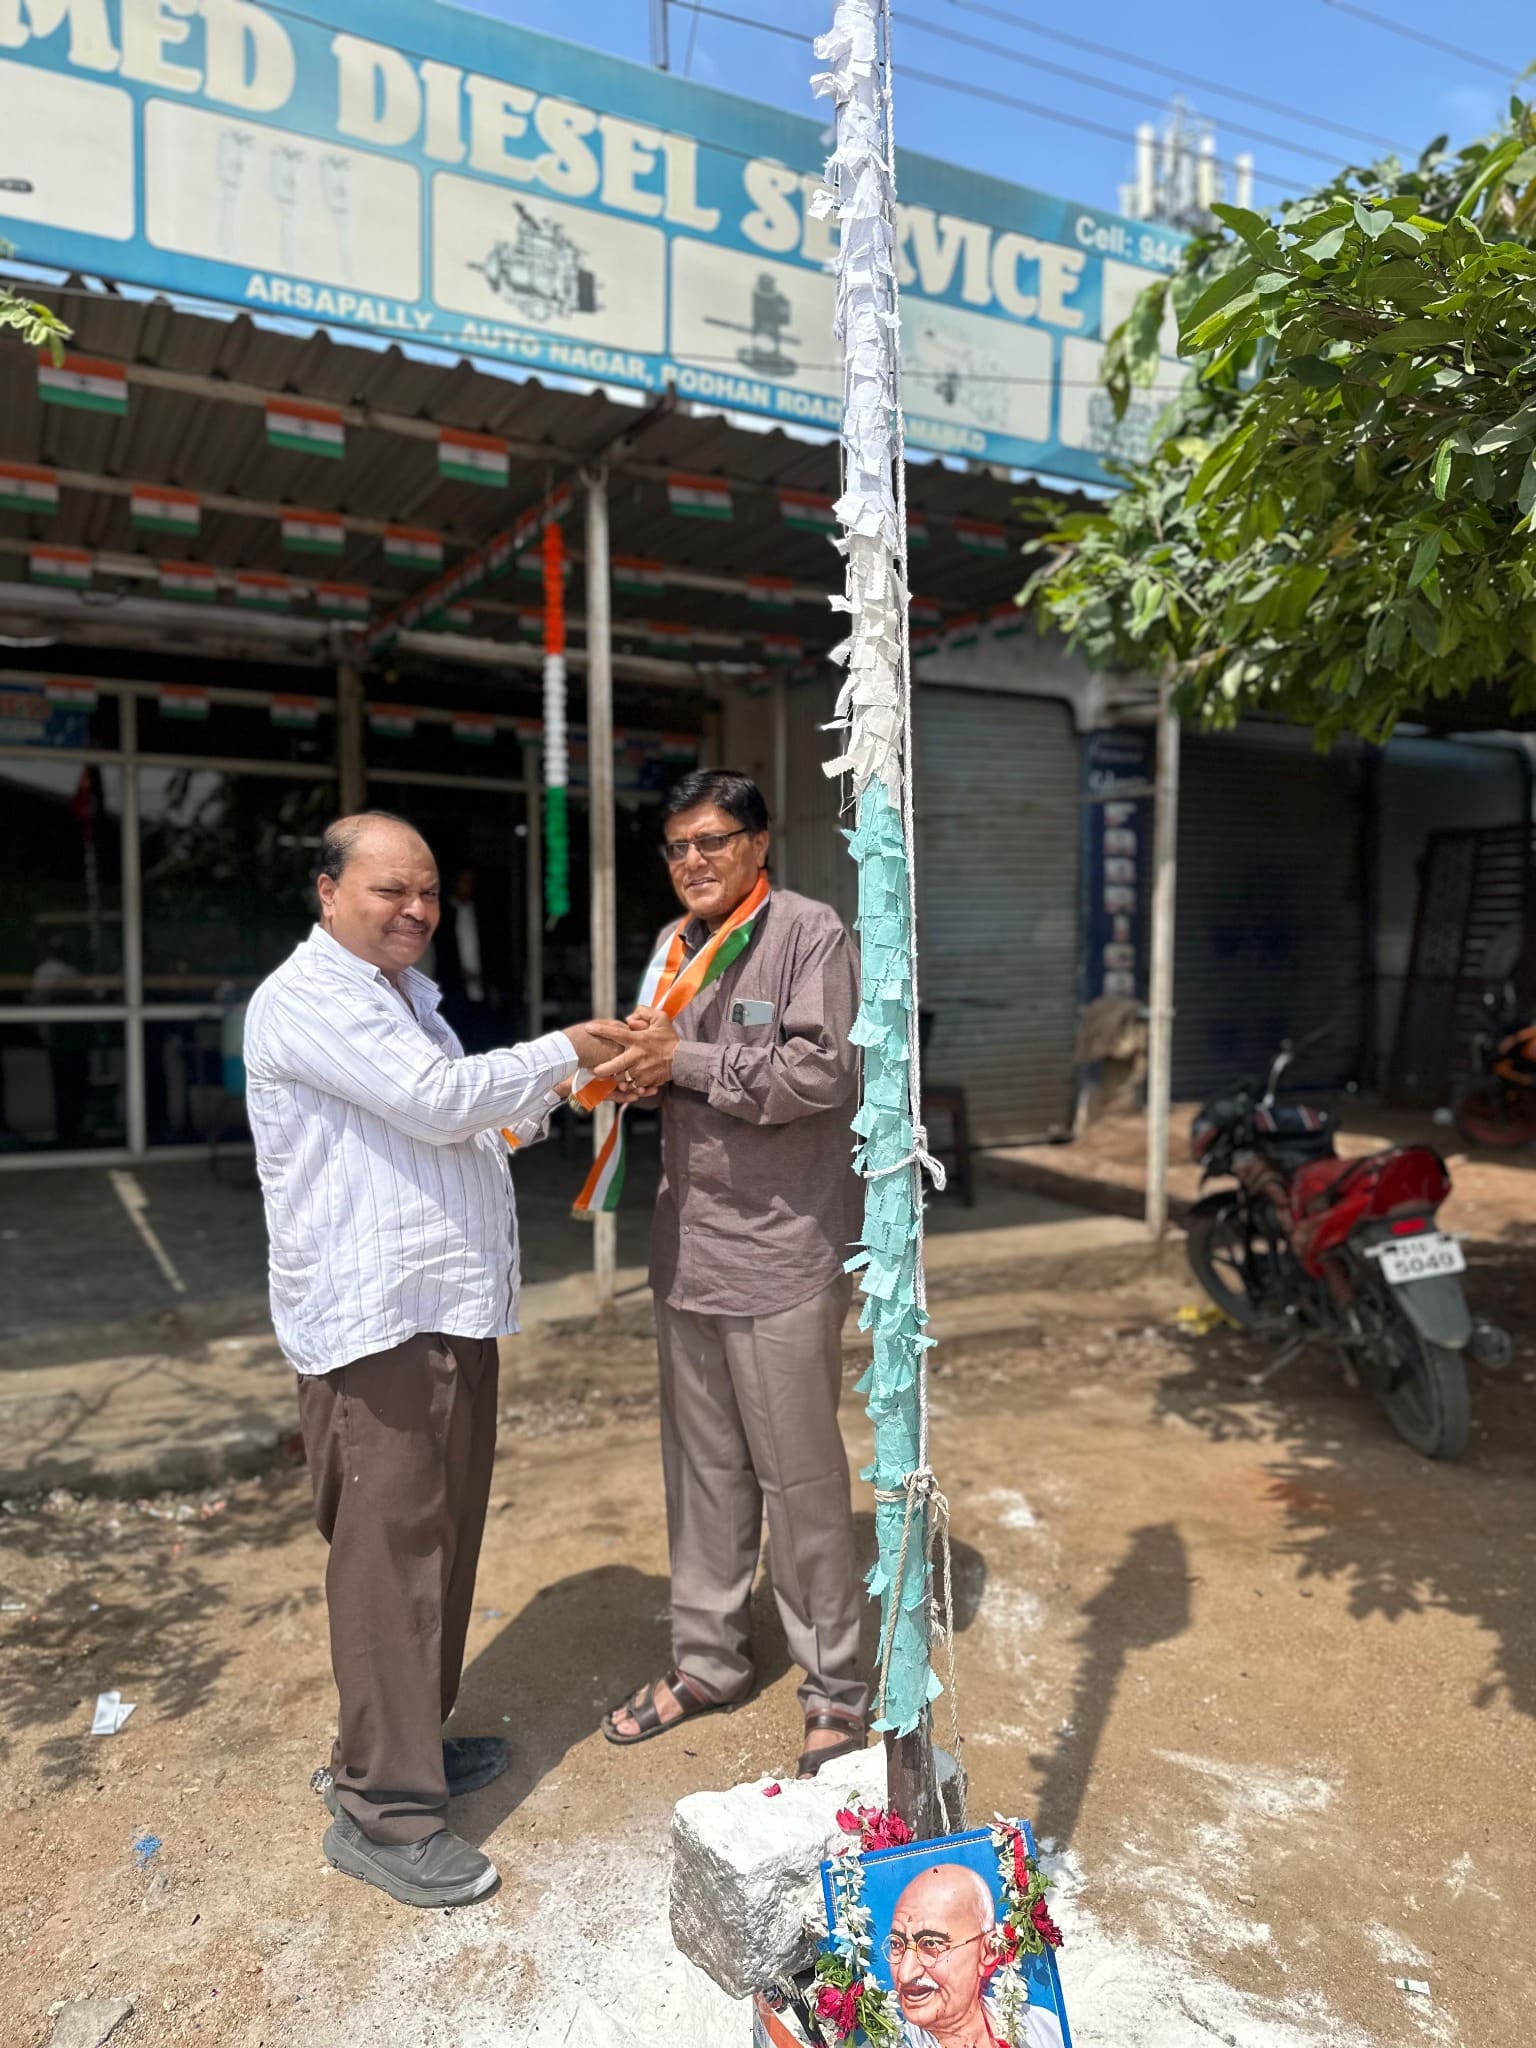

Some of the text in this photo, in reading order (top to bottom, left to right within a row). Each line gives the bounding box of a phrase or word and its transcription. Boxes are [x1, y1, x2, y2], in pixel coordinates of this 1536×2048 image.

[332, 31, 722, 232] DIESEL
[740, 157, 1086, 329] SEVICE
[1075, 215, 1134, 258] Cell:
[245, 274, 434, 331] ARSAPALLY
[461, 321, 542, 357] AUTO
[549, 344, 653, 387] NAGAR,
[775, 391, 840, 422] ROAD
[901, 415, 986, 453] MABAD
[1393, 1251, 1457, 1277] 5049
